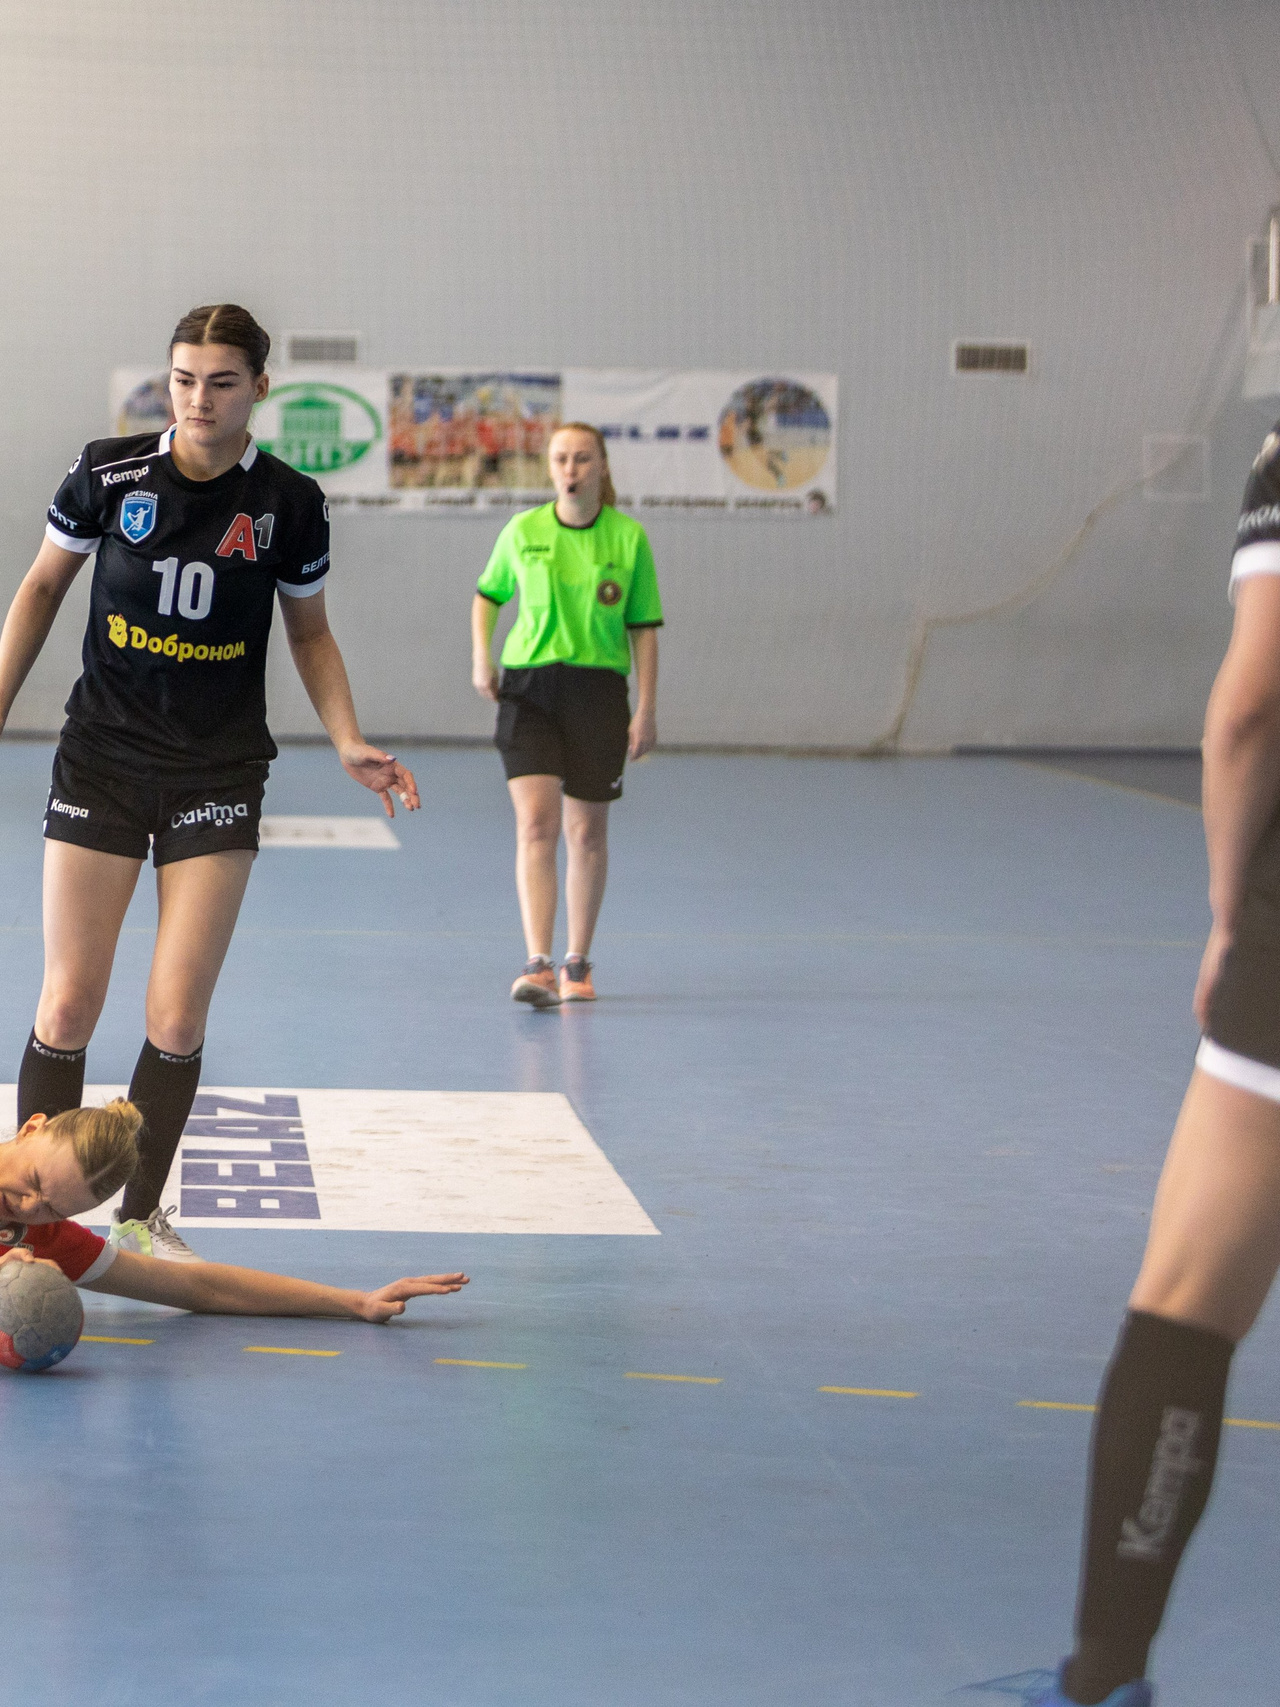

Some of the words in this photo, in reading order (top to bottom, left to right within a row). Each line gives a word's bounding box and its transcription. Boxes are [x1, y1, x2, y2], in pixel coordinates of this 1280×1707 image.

[101, 465, 149, 487] Kempa
[215, 512, 274, 561] A1
[152, 557, 214, 620] 10
[51, 798, 89, 818] Kempa
[180, 1094, 321, 1219] BELAZ
